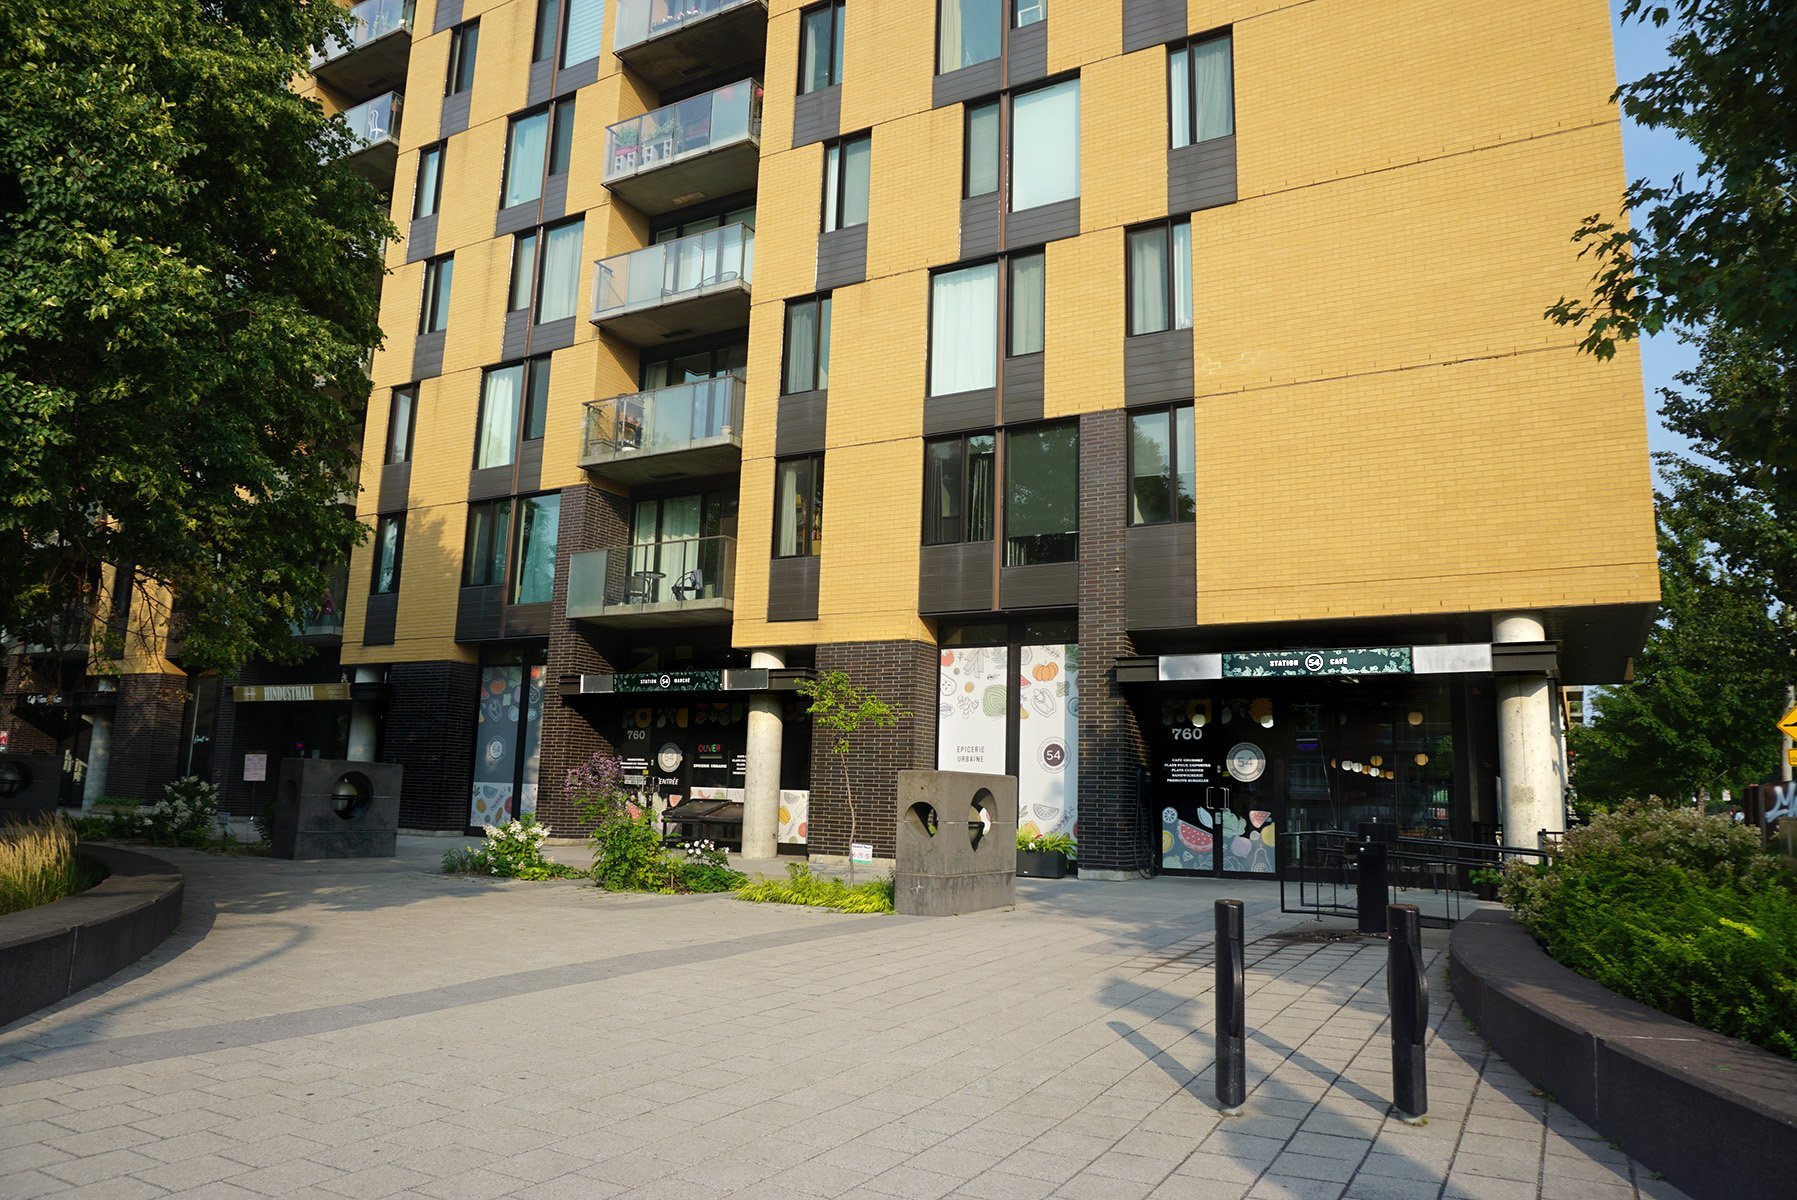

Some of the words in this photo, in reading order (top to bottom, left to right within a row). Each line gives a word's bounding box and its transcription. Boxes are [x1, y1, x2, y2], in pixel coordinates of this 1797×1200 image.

[1269, 659, 1298, 667] STATION
[1308, 658, 1320, 667] 54
[1329, 657, 1348, 665] CAFÉ
[627, 730, 646, 740] 760
[1171, 728, 1203, 740] 760
[957, 755, 984, 763] URBAINE
[1046, 750, 1061, 761] 54
[1238, 756, 1253, 768] 54
[658, 777, 679, 785] ENTRÉE
